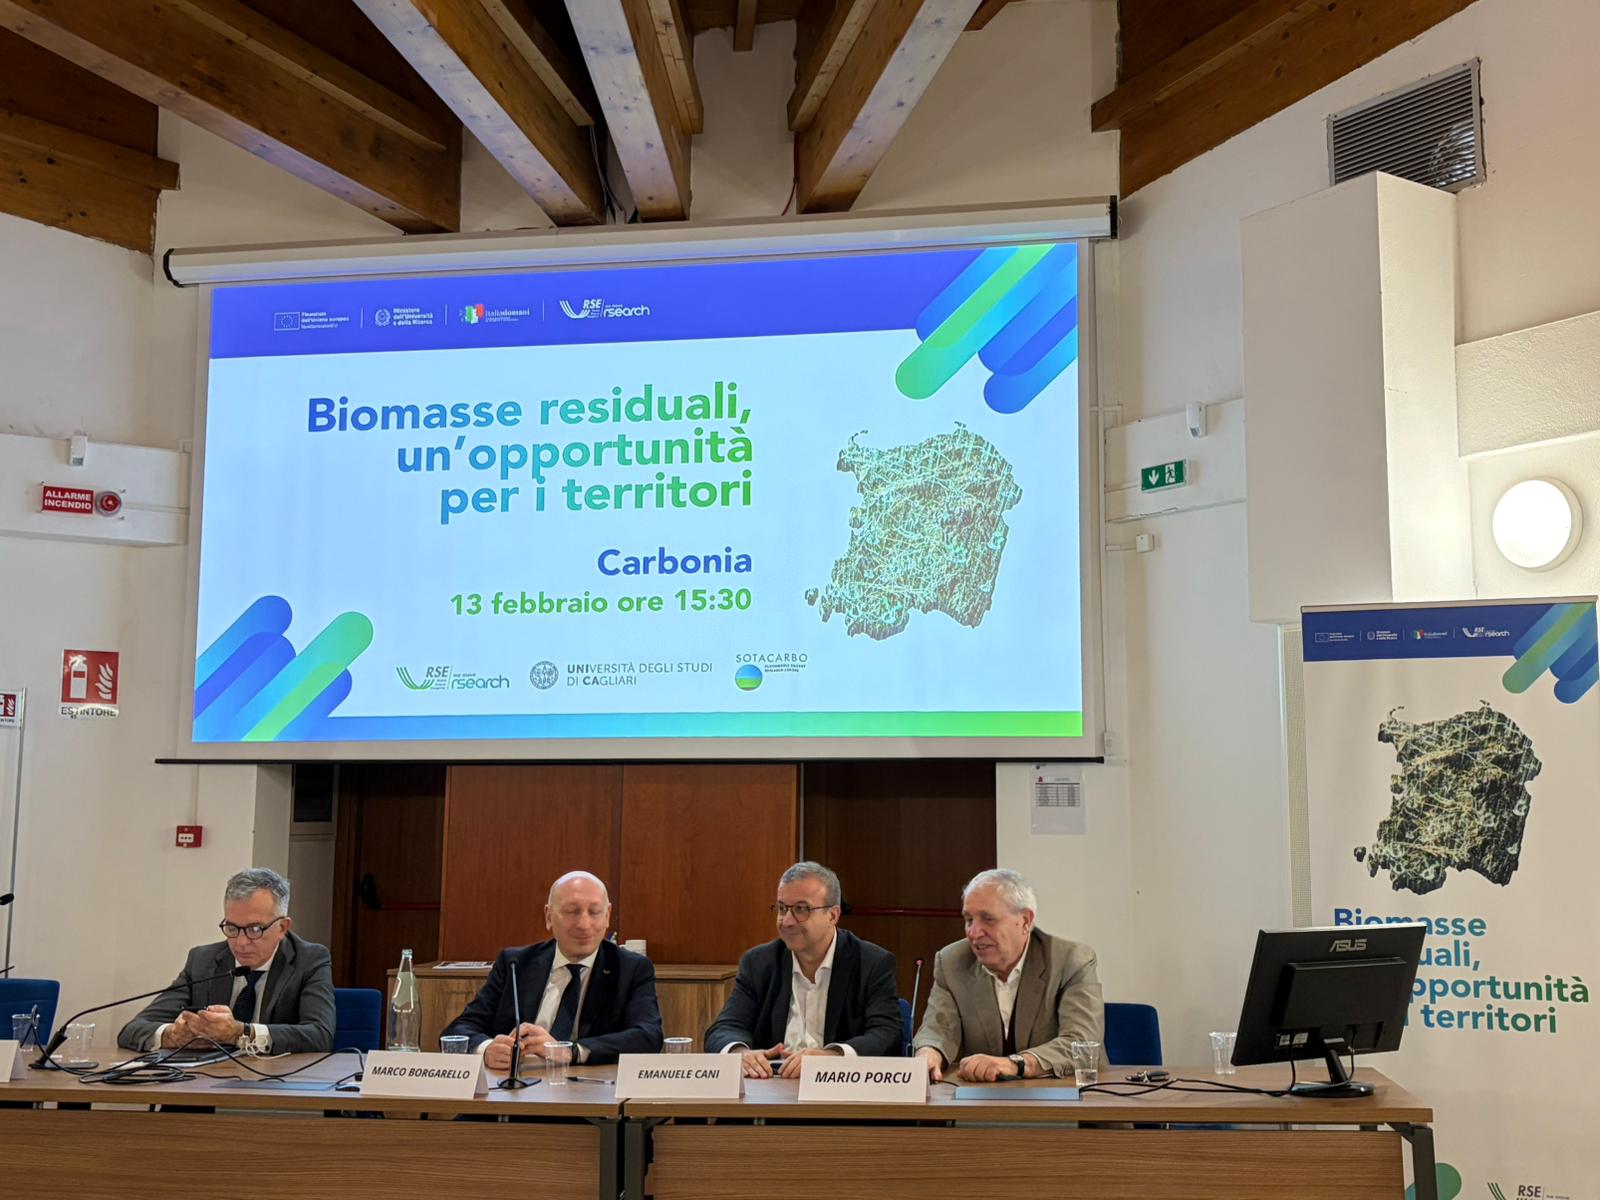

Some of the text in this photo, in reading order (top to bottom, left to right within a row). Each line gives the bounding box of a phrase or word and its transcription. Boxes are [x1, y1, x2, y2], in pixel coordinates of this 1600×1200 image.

[583, 299, 602, 309] RSE
[603, 305, 650, 318] rsearch
[308, 381, 752, 433] Biomasse residuali,
[397, 426, 753, 480] un'opportunità
[45, 490, 91, 501] ALLARME
[440, 469, 753, 525] per i territori
[44, 499, 92, 510] INCENDIO
[597, 546, 752, 575] Carbonia
[450, 588, 752, 615] 13 febbraio ore 15:30
[736, 653, 808, 663] SOTACARBO
[425, 665, 450, 678] RSE
[567, 661, 713, 674] UNIVERSITÀ DEGLI STUDI
[451, 674, 510, 689] rsearch
[567, 675, 637, 686] DI CAGLIARI
[1329, 938, 1367, 953] ASUS
[1410, 975, 1590, 1004] pportunità
[1420, 1005, 1556, 1033] territori
[371, 1066, 471, 1080] MARCO BORGARELLO
[638, 1069, 720, 1079] EMANUELE CANI
[815, 1071, 912, 1084] MARIO PORCU
[1518, 1185, 1542, 1198] RSE
